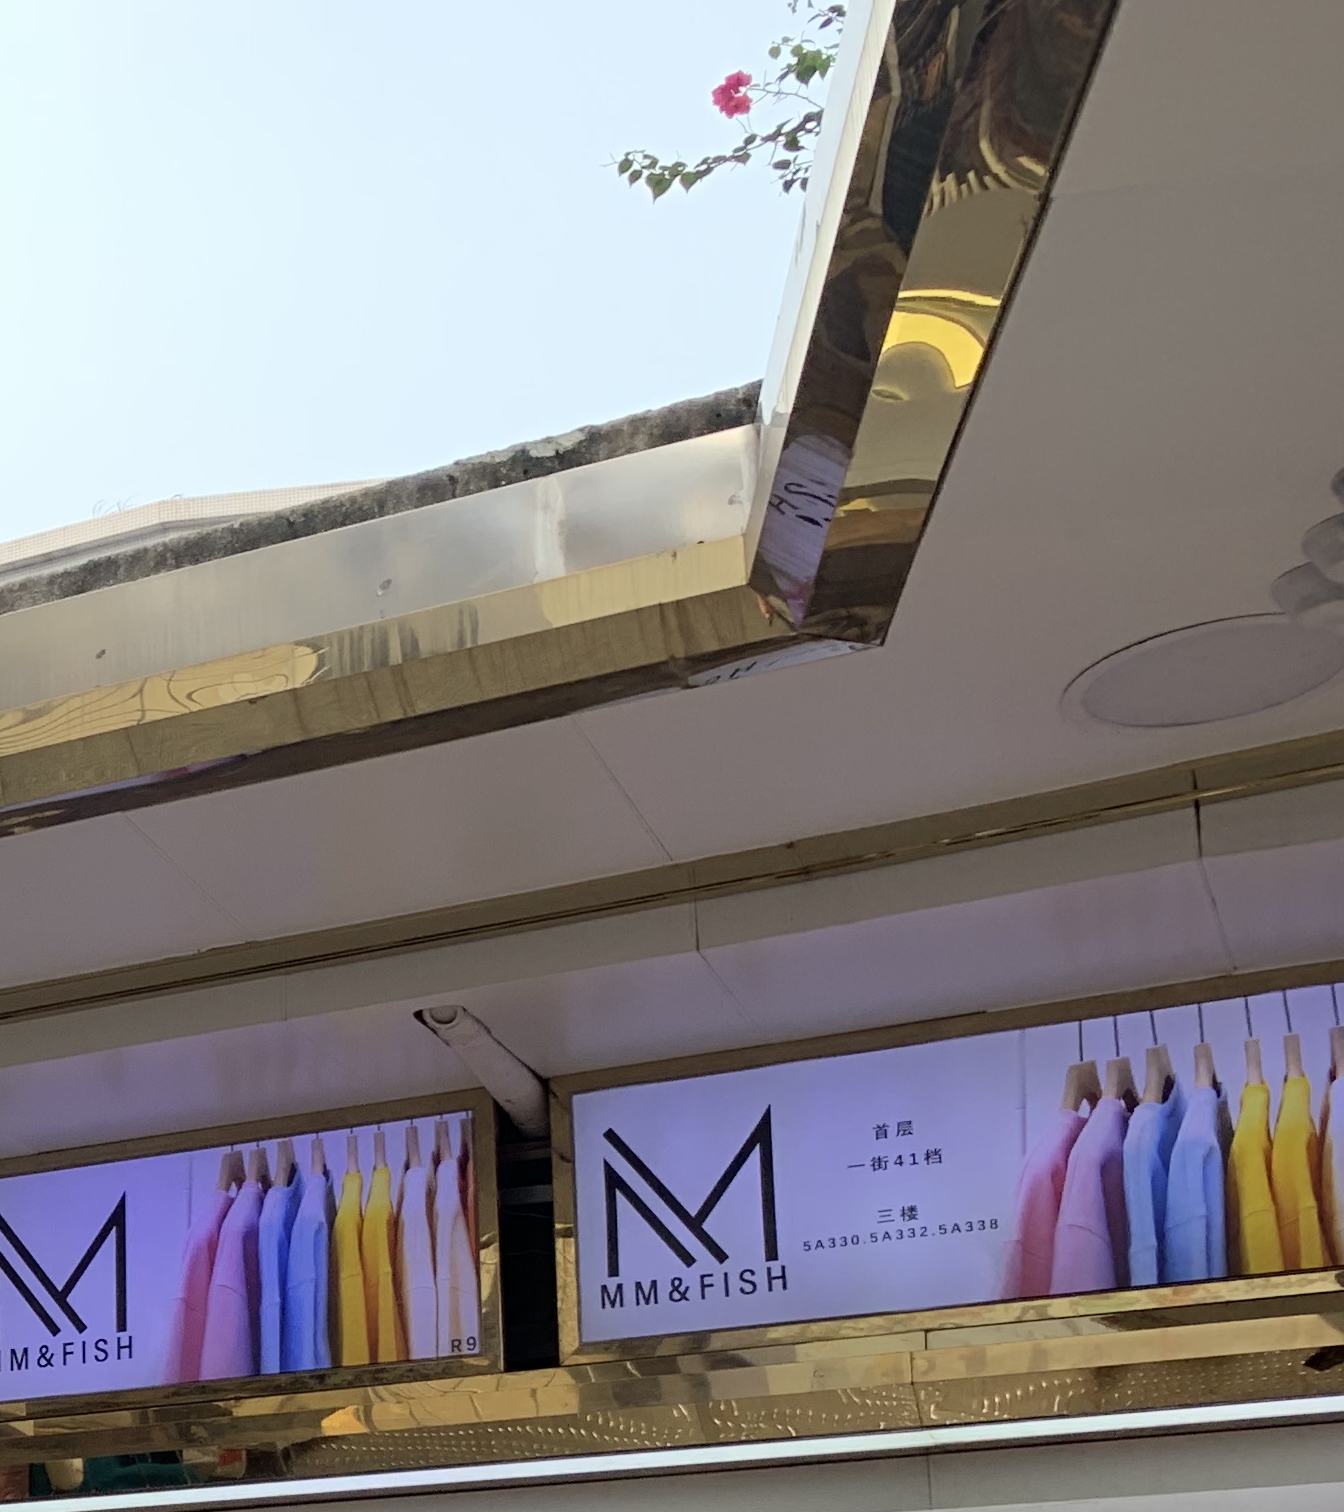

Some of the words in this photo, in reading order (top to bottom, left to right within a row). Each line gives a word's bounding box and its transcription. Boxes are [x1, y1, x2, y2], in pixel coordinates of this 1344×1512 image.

[872, 1120, 914, 1141] 首层
[847, 1148, 943, 1172] 一街41档
[876, 1204, 920, 1225] 三楼
[599, 1264, 789, 1311] MM&FISH
